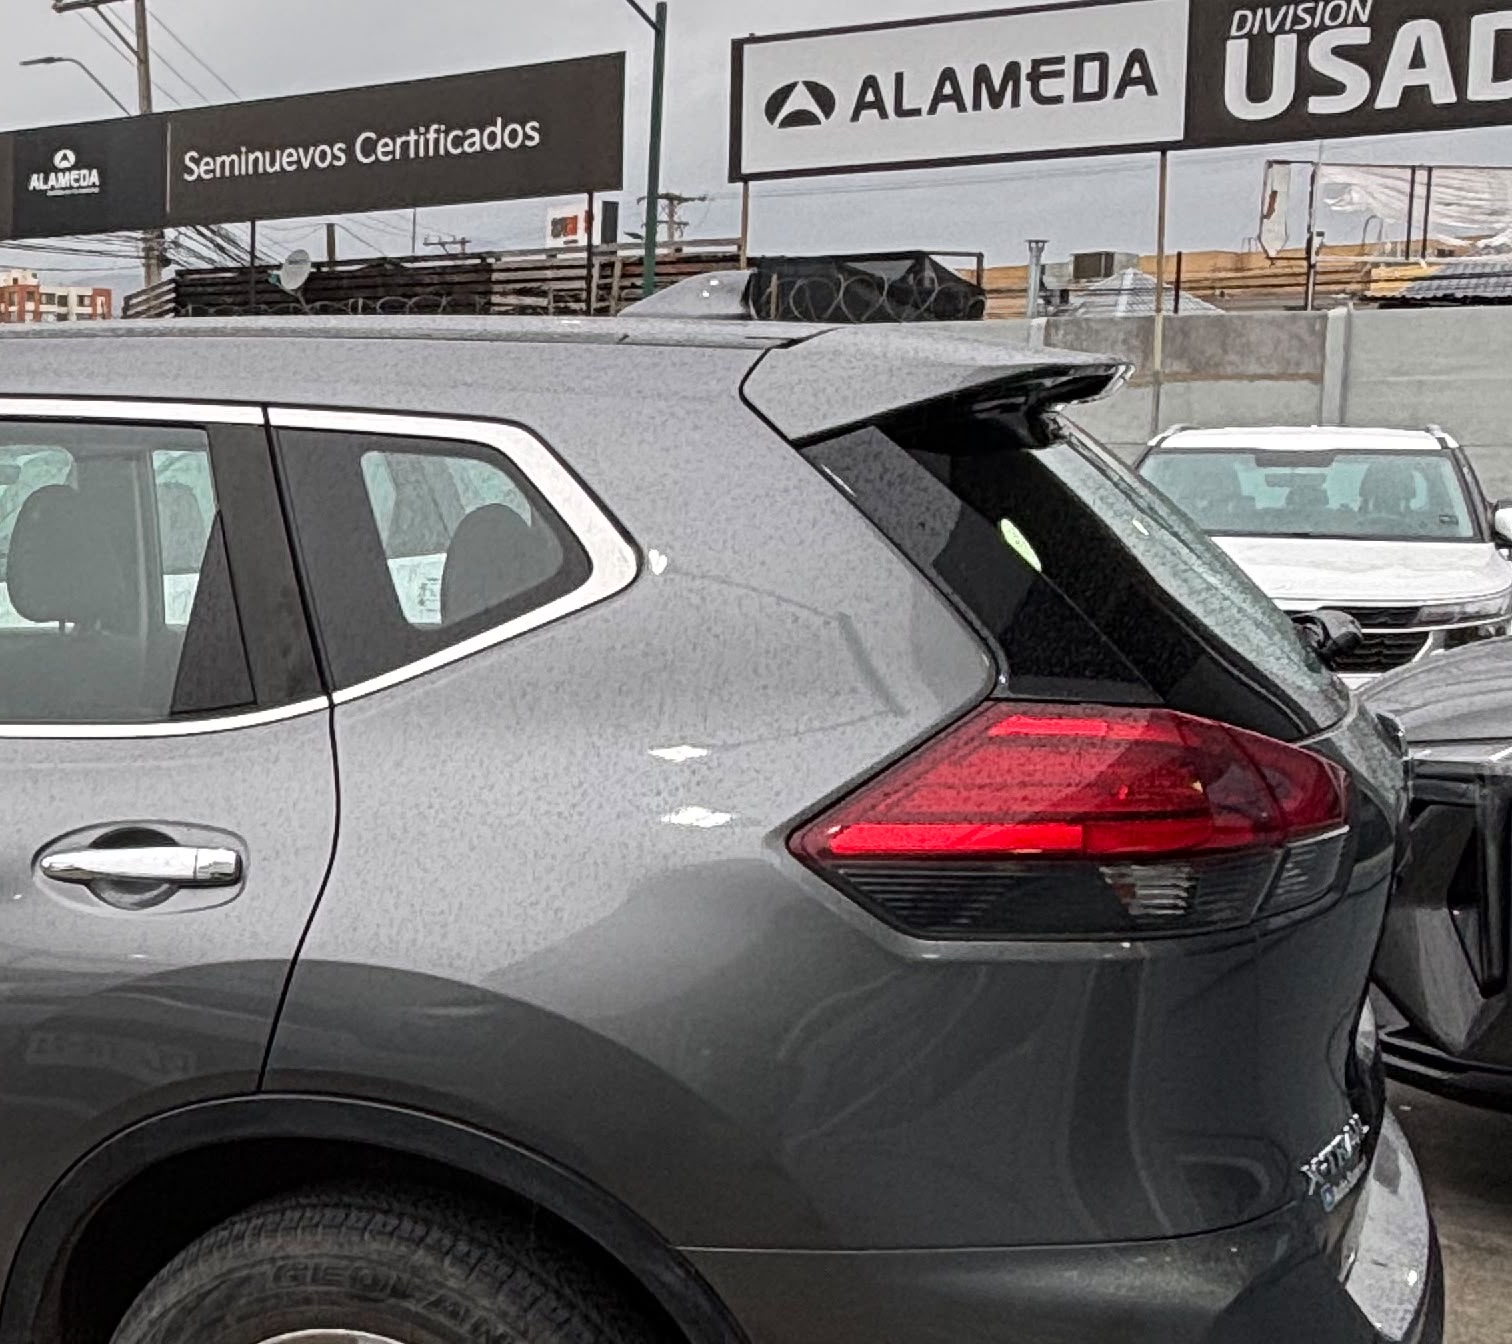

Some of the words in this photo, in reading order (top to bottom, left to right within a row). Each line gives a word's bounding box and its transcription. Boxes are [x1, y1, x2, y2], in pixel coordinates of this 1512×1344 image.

[849, 48, 1158, 123] ALAMEDA
[28, 168, 100, 191] ALAMEDA
[183, 142, 346, 182] Seminuevos
[354, 116, 540, 164] Certificados
